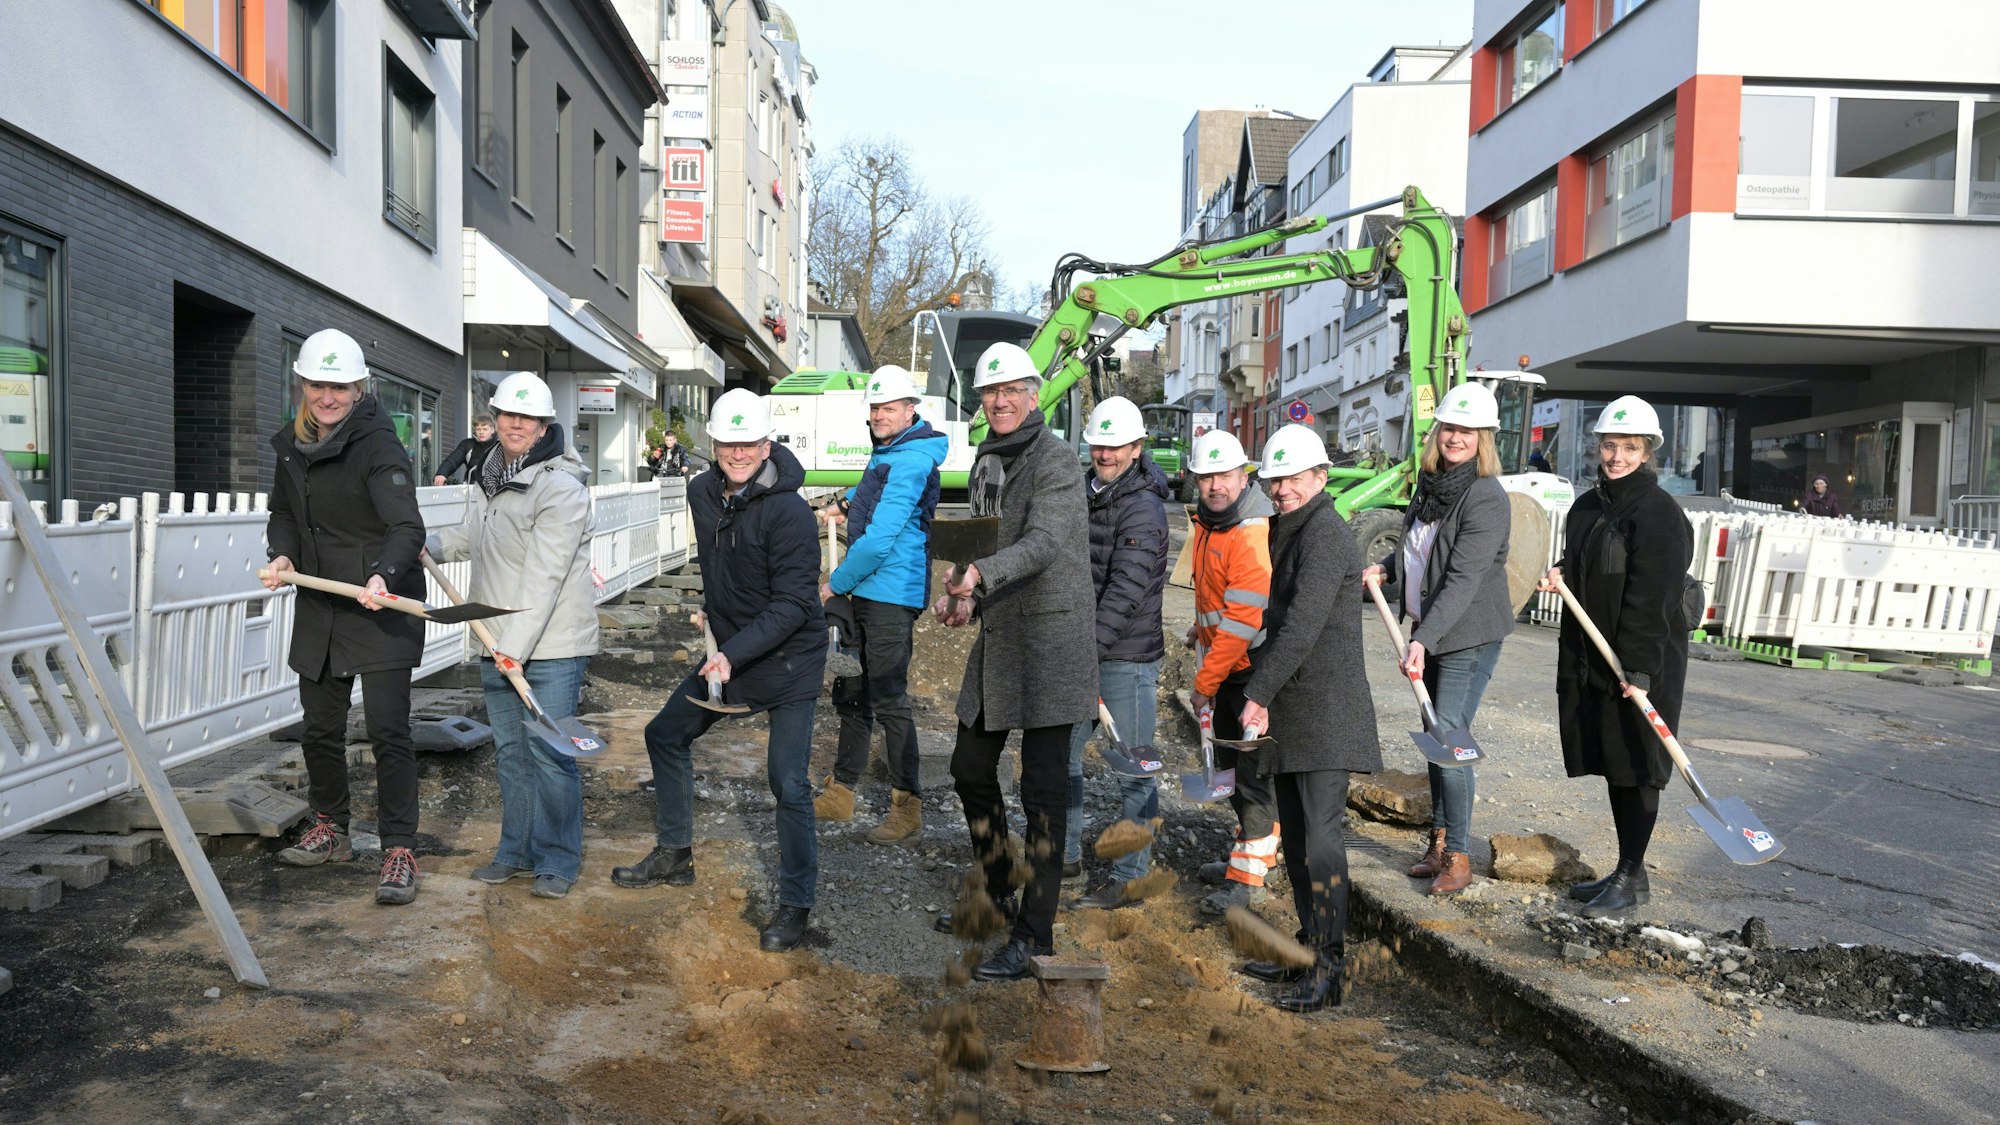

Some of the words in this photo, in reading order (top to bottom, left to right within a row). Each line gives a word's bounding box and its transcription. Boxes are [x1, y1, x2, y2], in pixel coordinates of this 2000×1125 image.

[667, 55, 705, 65] SCHLOSS
[672, 110, 703, 119] ACTION
[671, 160, 698, 182] fit
[1746, 184, 1800, 195] Osteopathie
[666, 209, 692, 217] Fitness.
[665, 216, 703, 225] Gesundheit.
[665, 224, 696, 232] Lifestyle.
[1203, 270, 1297, 293] www.boymann.de
[796, 436, 807, 448] 20
[1862, 497, 1894, 512] ROBERTZ
